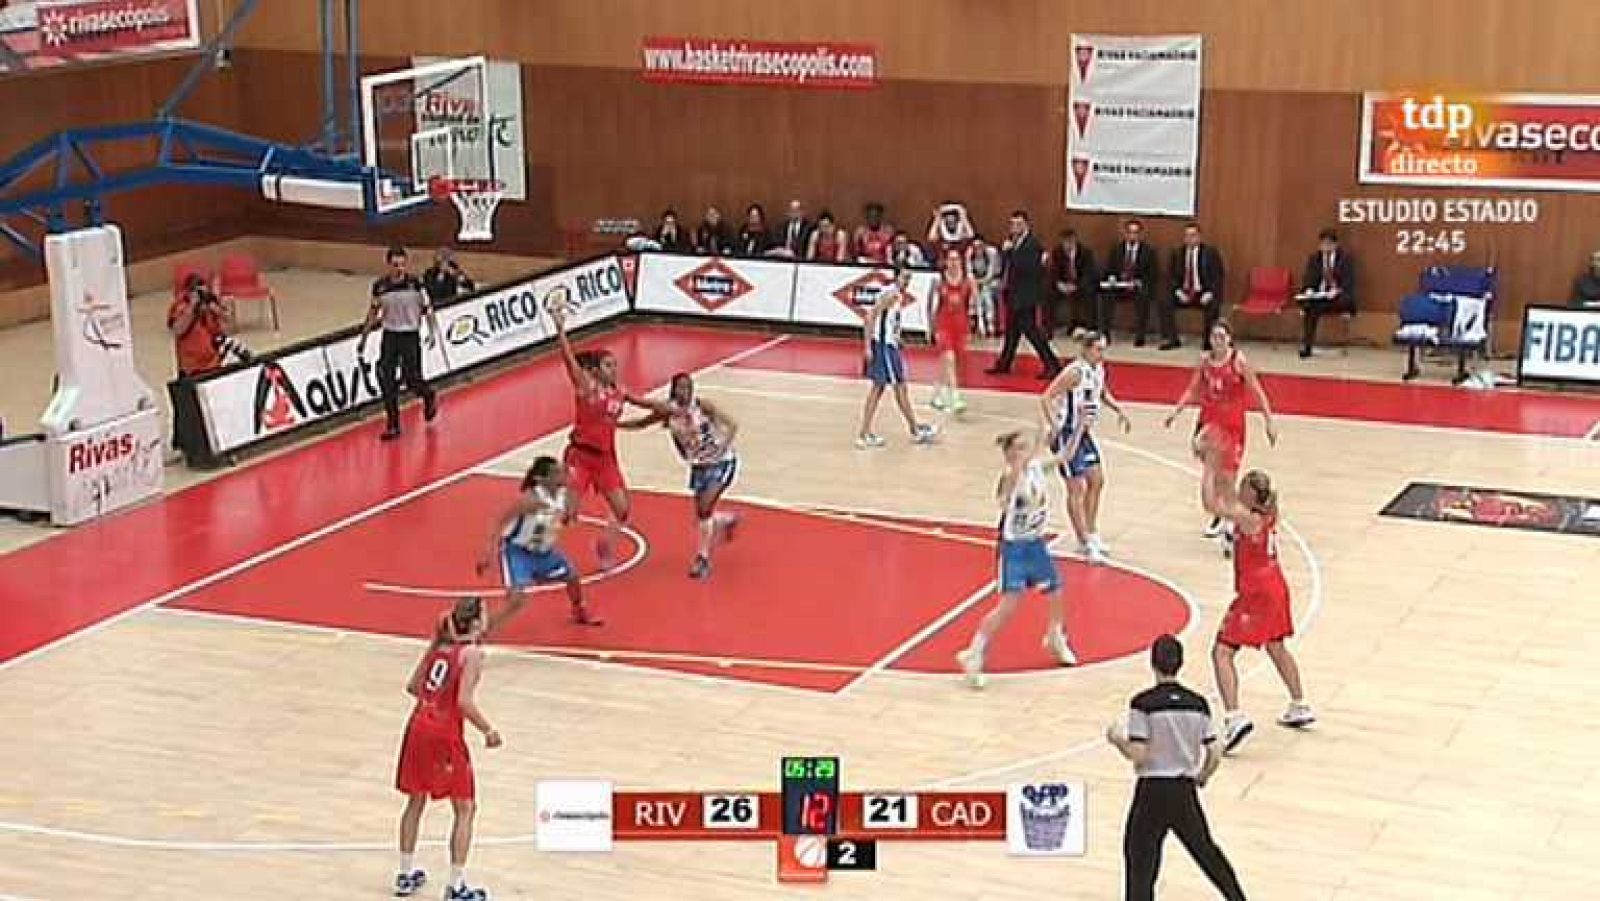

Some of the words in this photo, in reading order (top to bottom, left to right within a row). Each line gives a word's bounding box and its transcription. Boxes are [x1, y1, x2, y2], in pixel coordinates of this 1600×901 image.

[574, 263, 622, 303] RICO
[484, 291, 538, 333] RICO
[1523, 321, 1600, 364] FIBA
[69, 433, 134, 474] Rivas
[426, 660, 450, 692] 9
